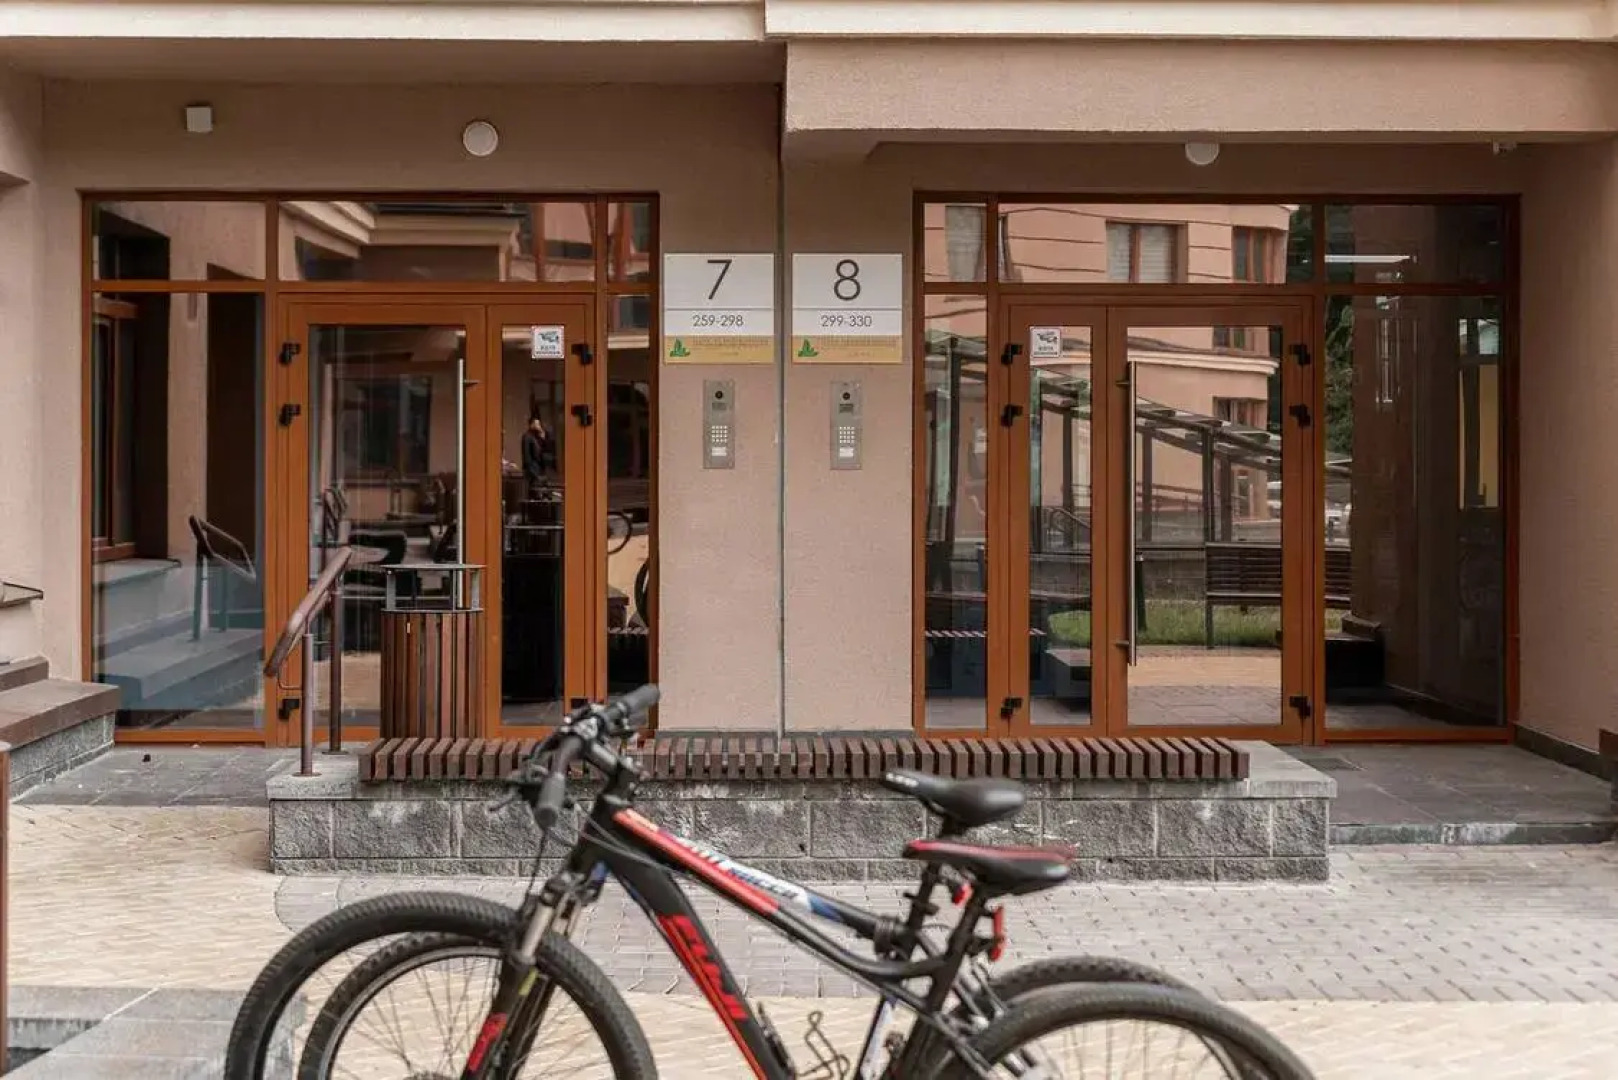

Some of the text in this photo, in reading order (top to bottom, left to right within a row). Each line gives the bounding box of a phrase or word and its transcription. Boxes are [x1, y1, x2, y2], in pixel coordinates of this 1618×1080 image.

[706, 258, 733, 301] 7
[833, 258, 862, 301] 8
[692, 314, 744, 327] 259-298
[821, 314, 873, 327] 299-330
